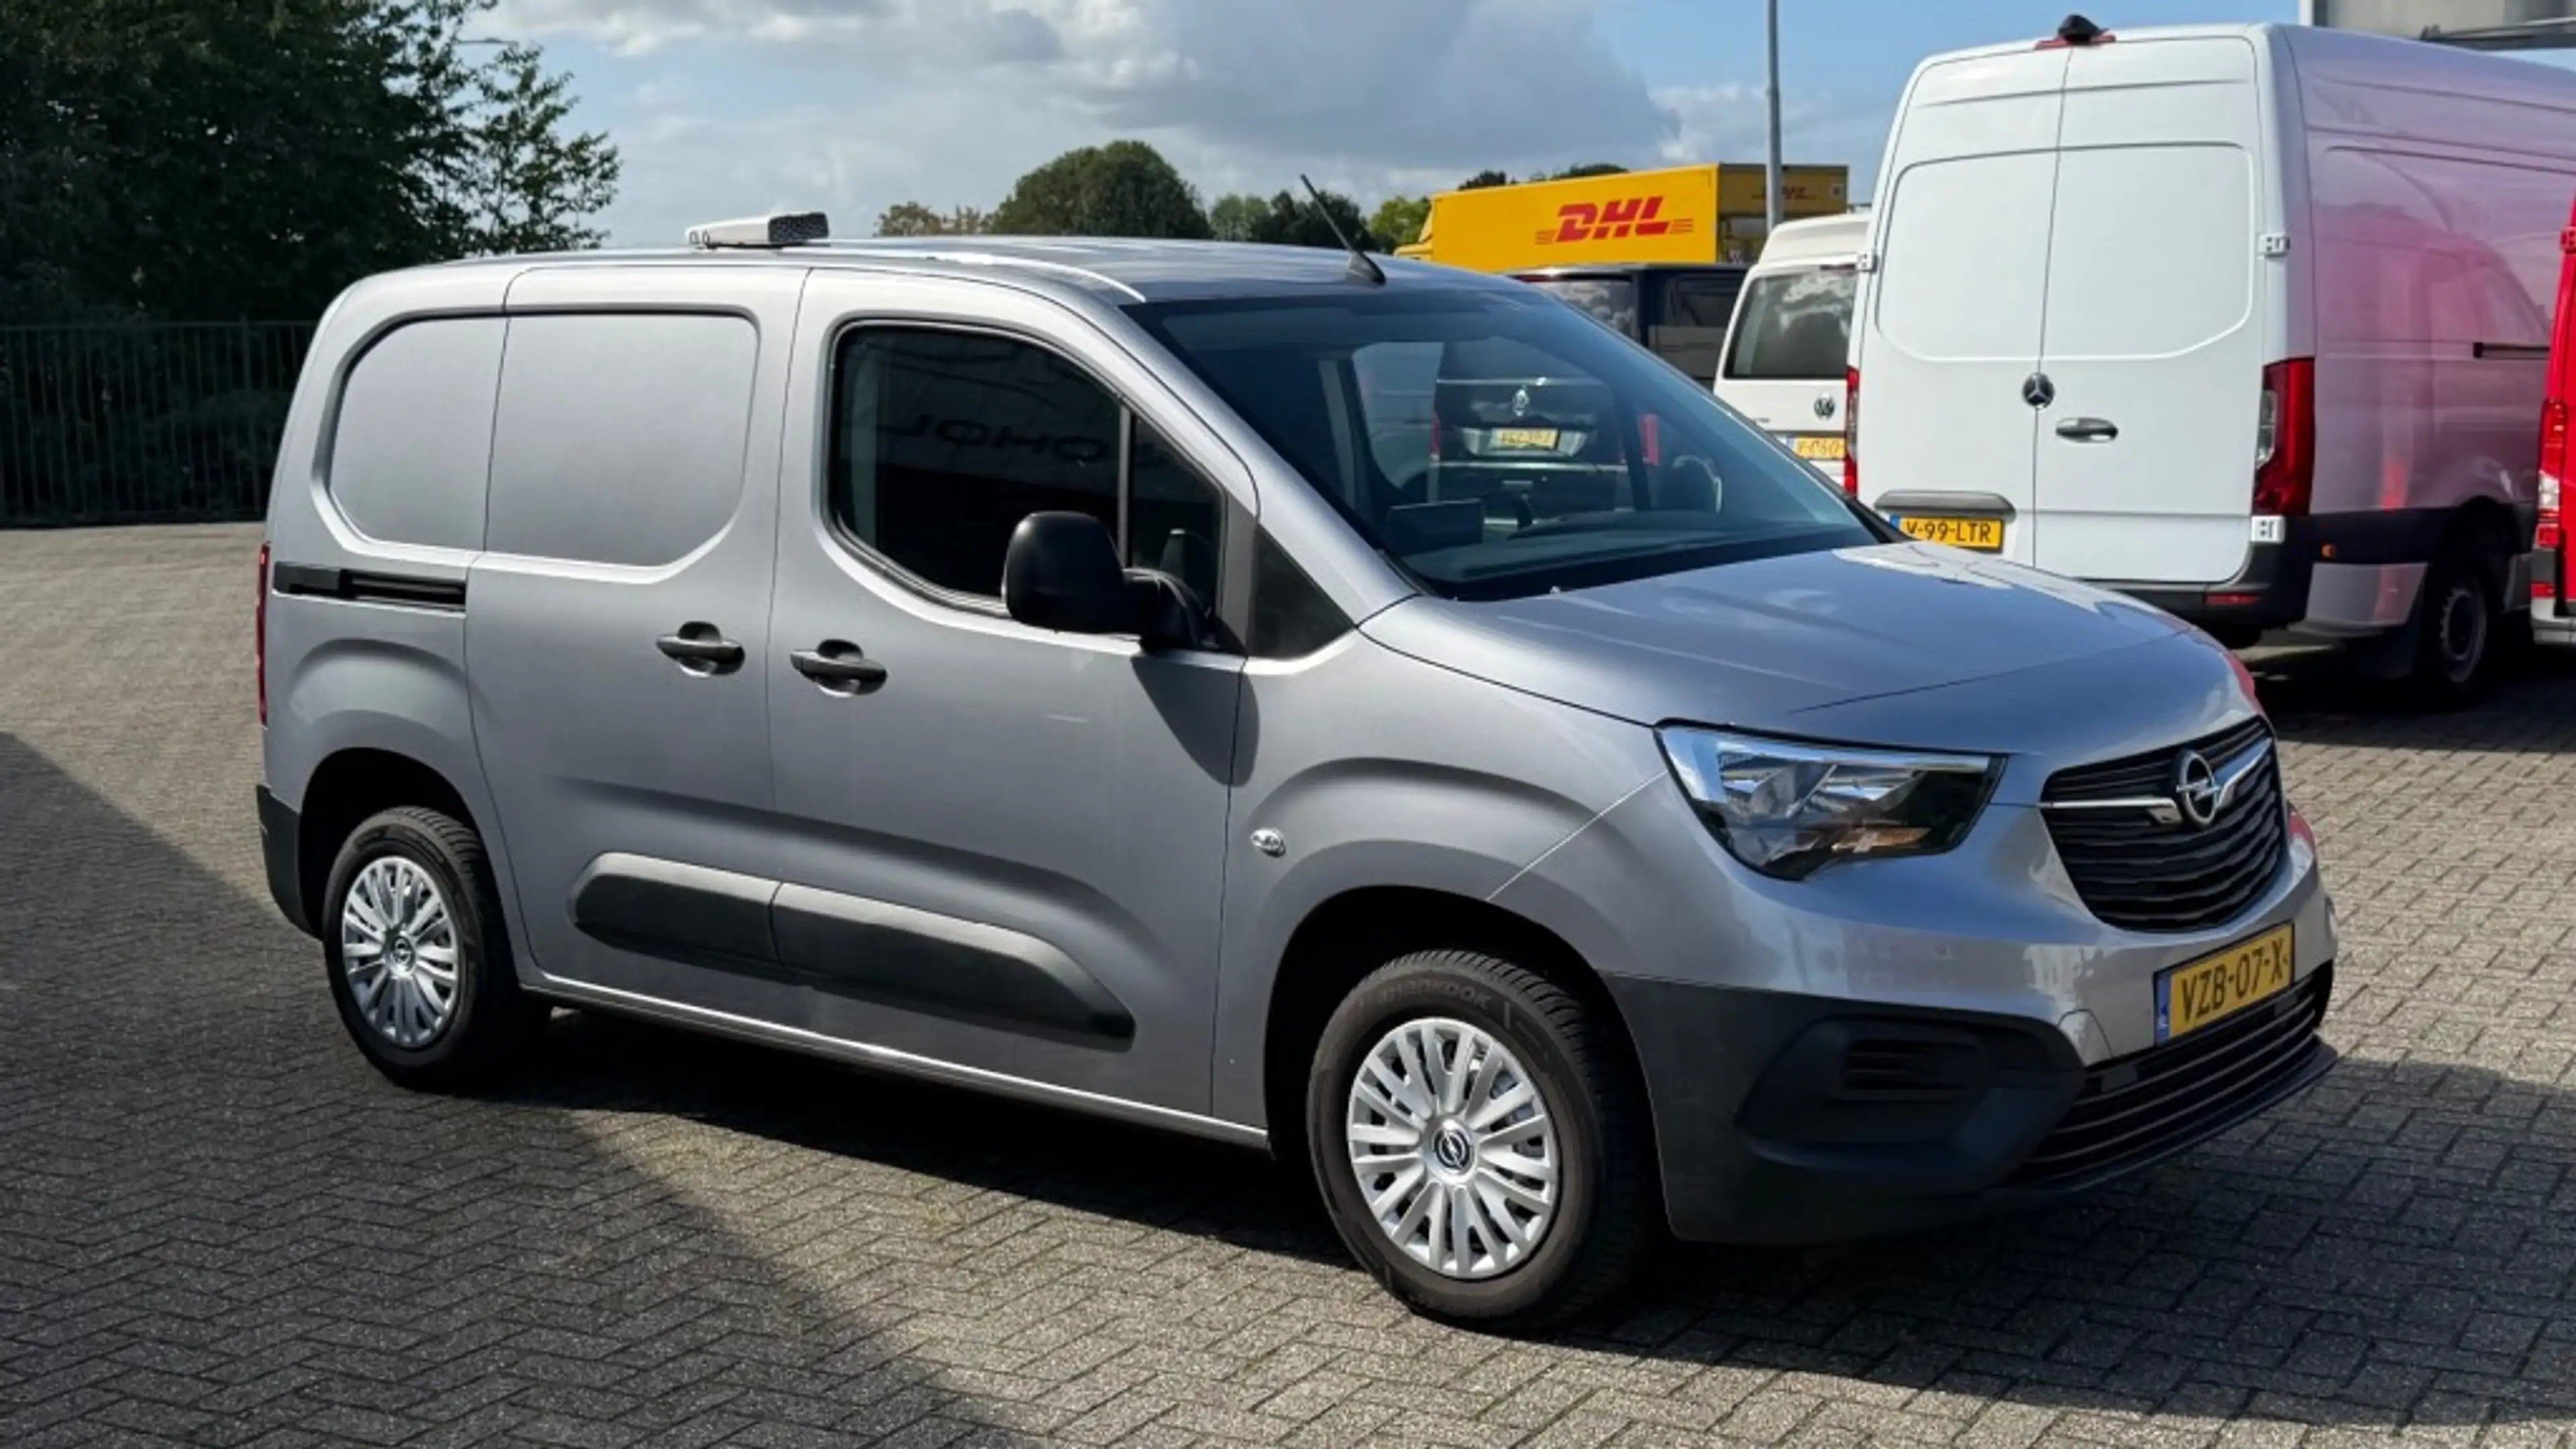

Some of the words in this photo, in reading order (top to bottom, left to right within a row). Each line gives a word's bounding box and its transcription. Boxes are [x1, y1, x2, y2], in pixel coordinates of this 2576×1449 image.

[1554, 195, 1670, 243] DHL
[1906, 517, 1991, 543] V-99-LTR
[2181, 936, 2284, 1023] VZB-07-X
